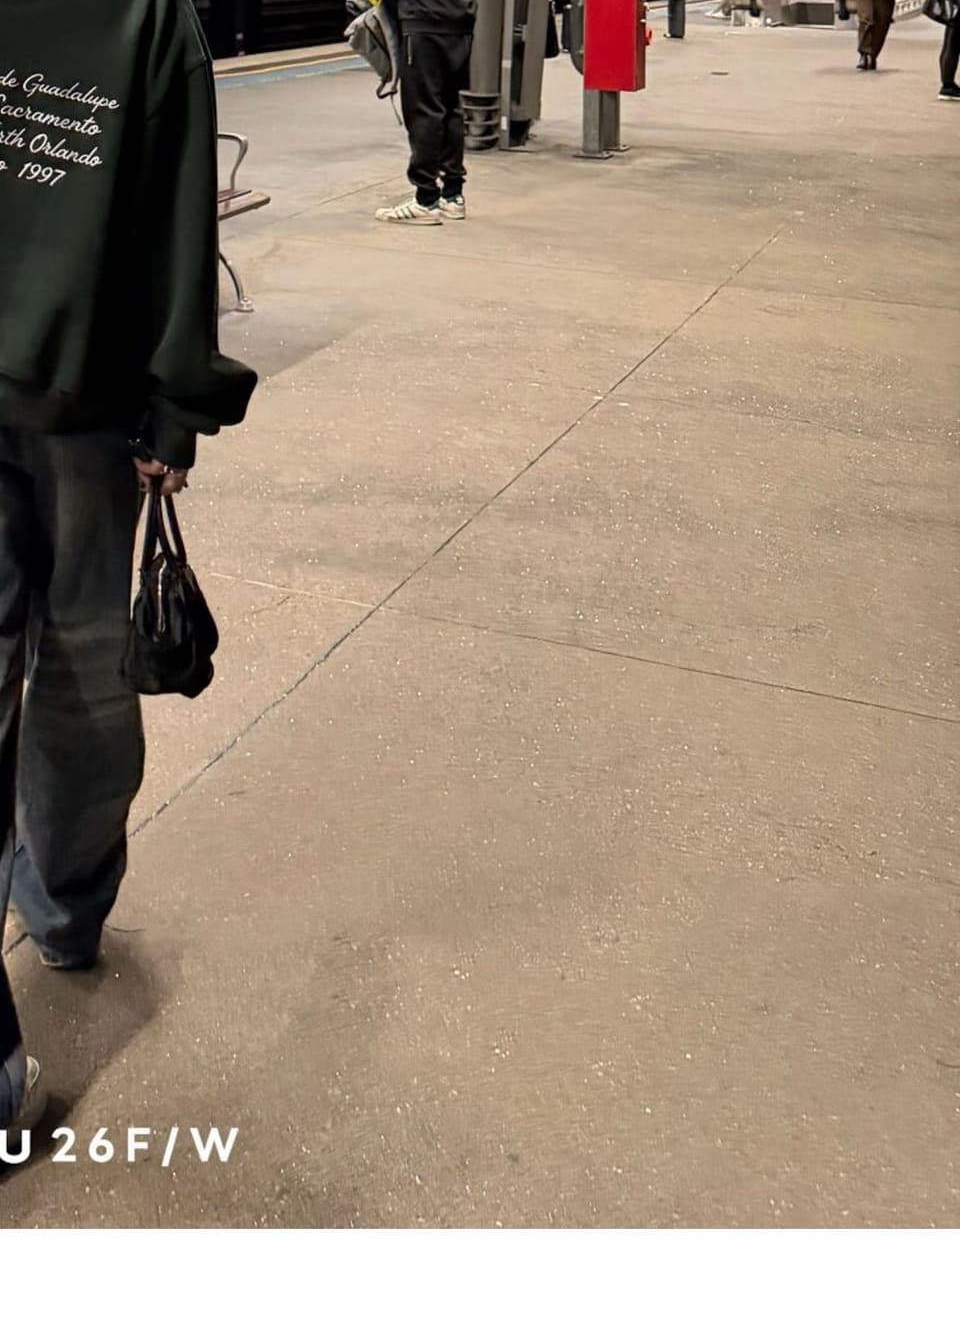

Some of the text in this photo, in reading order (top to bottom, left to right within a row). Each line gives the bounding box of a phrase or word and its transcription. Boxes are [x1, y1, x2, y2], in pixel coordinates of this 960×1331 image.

[22, 73, 121, 113] Guadalupe
[29, 132, 103, 168] Orlando
[16, 161, 67, 187] 1997
